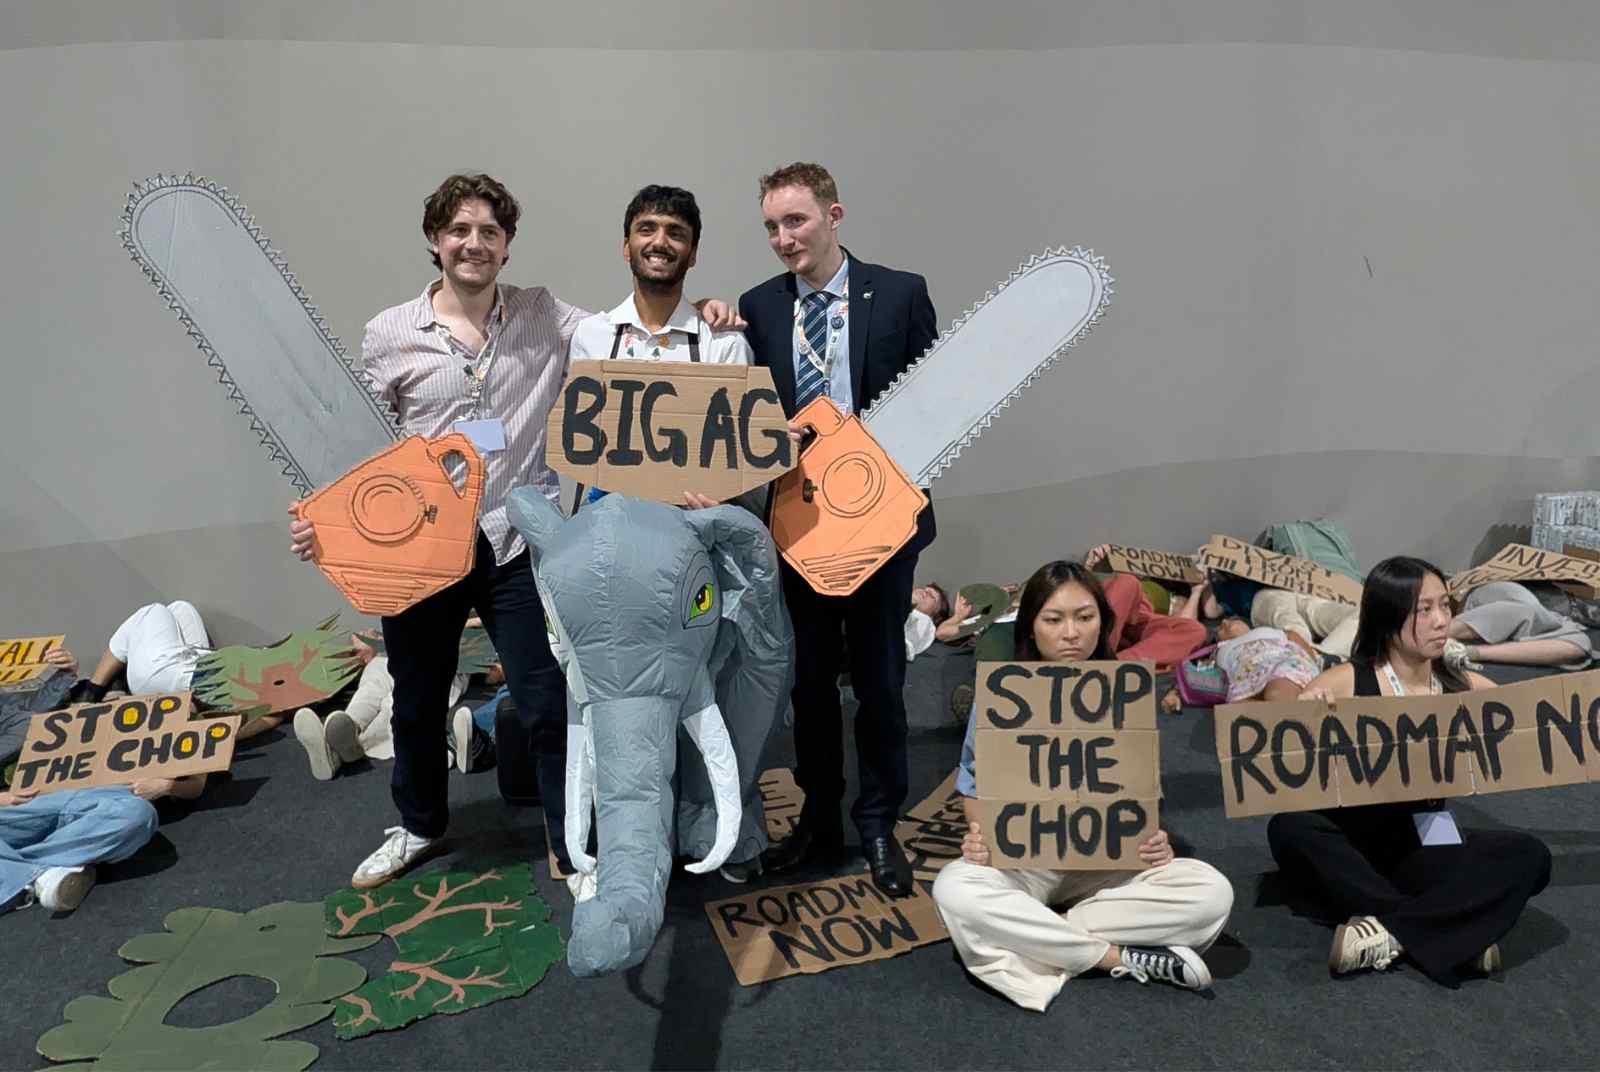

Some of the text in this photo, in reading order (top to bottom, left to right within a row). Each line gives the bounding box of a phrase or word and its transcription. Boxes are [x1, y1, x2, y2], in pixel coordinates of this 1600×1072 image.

[562, 376, 791, 470] BIG AG
[1126, 559, 1185, 580] NOW
[32, 696, 182, 752] STOP
[986, 663, 1153, 730] STOP
[17, 722, 231, 789] THE CHOP
[1016, 734, 1123, 793] THE
[1230, 701, 1515, 804] ROADMAP
[995, 799, 1147, 861] CHOP
[718, 879, 917, 938] ROADM
[768, 906, 919, 969] NOW
